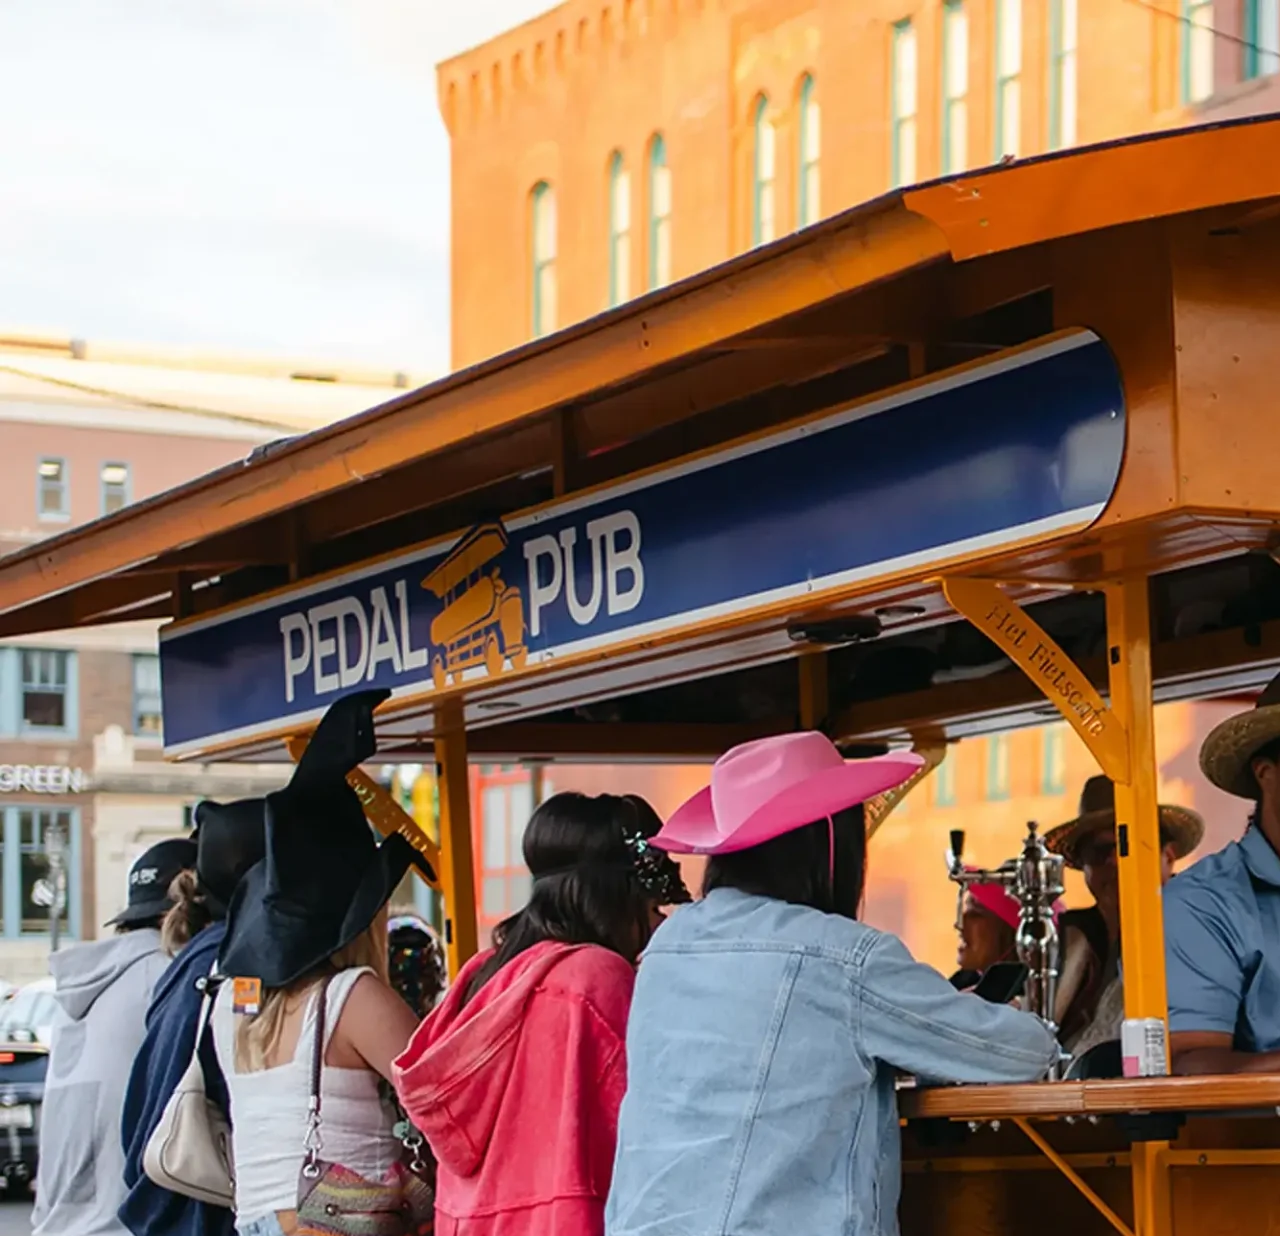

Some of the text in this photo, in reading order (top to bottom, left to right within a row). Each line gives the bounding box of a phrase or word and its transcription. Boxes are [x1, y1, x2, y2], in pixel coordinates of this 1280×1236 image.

[279, 509, 645, 703] PEDAL PUB
[985, 603, 1028, 648] Het
[0, 764, 84, 794] GREEN
